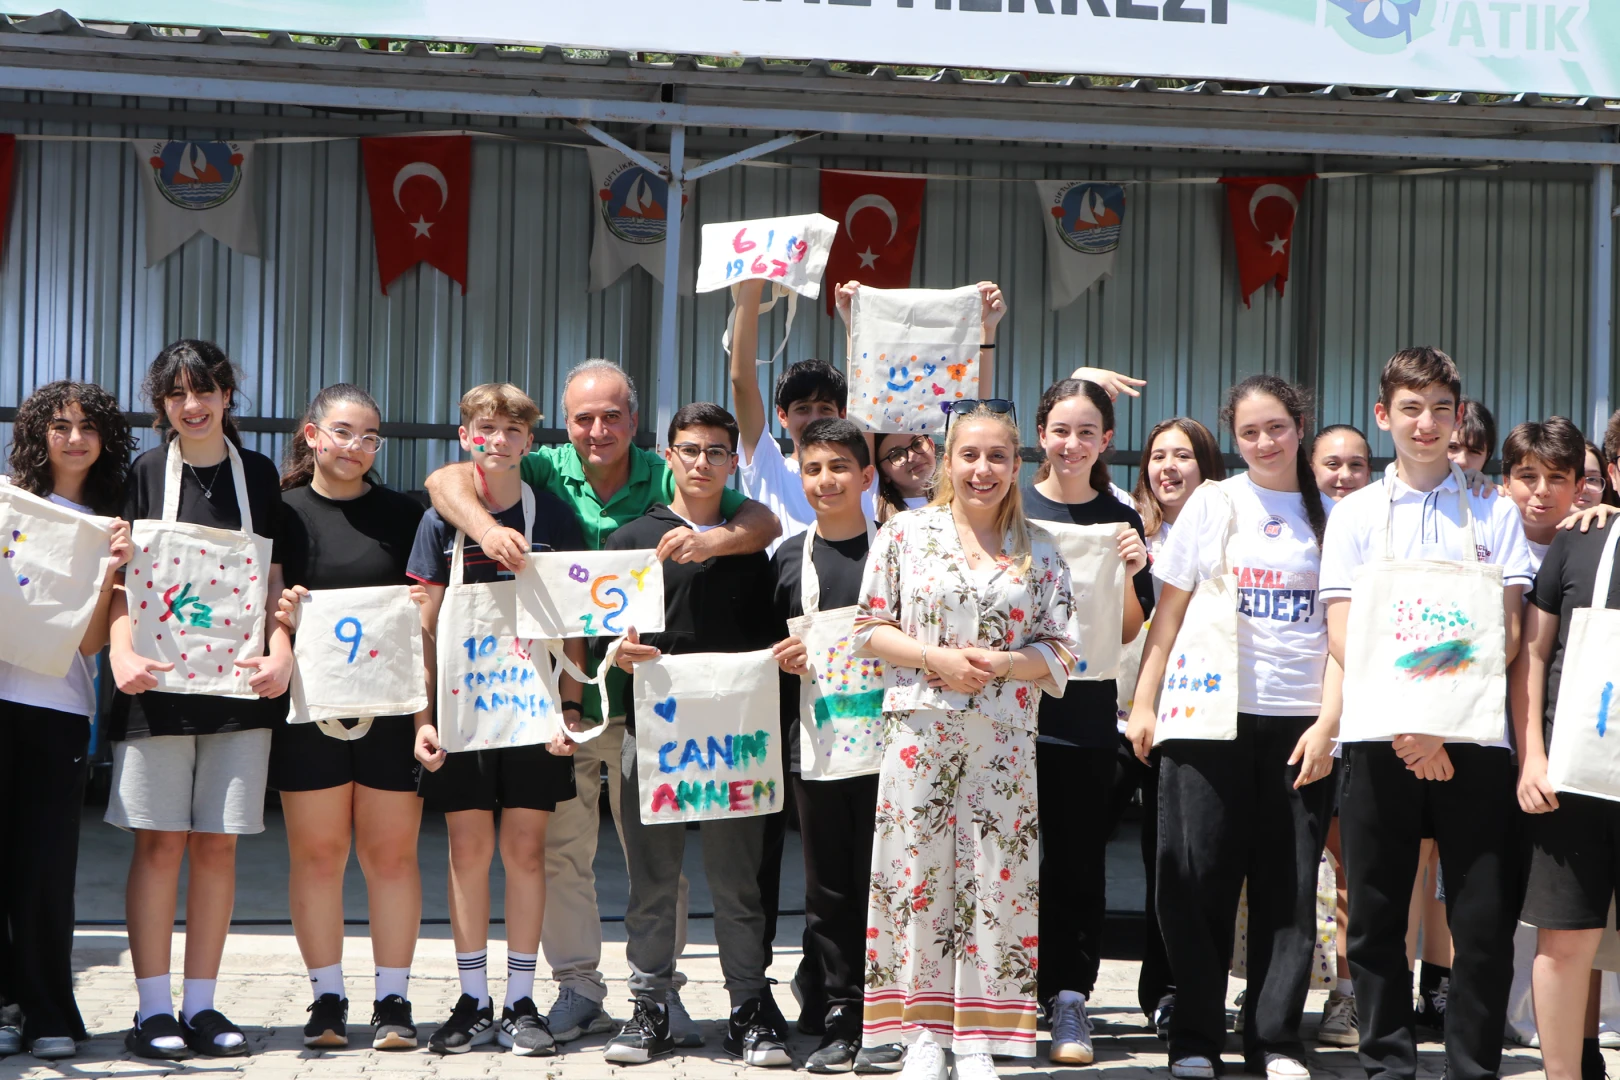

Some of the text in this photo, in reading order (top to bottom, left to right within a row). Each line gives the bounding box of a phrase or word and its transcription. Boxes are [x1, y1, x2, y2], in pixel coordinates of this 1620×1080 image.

[1448, 2, 1581, 52] ATIK
[1237, 588, 1316, 623] EDEF!
[334, 616, 363, 664] 9
[463, 635, 497, 662] 10
[658, 729, 770, 774] CANIM
[651, 778, 776, 814] ANNEM
